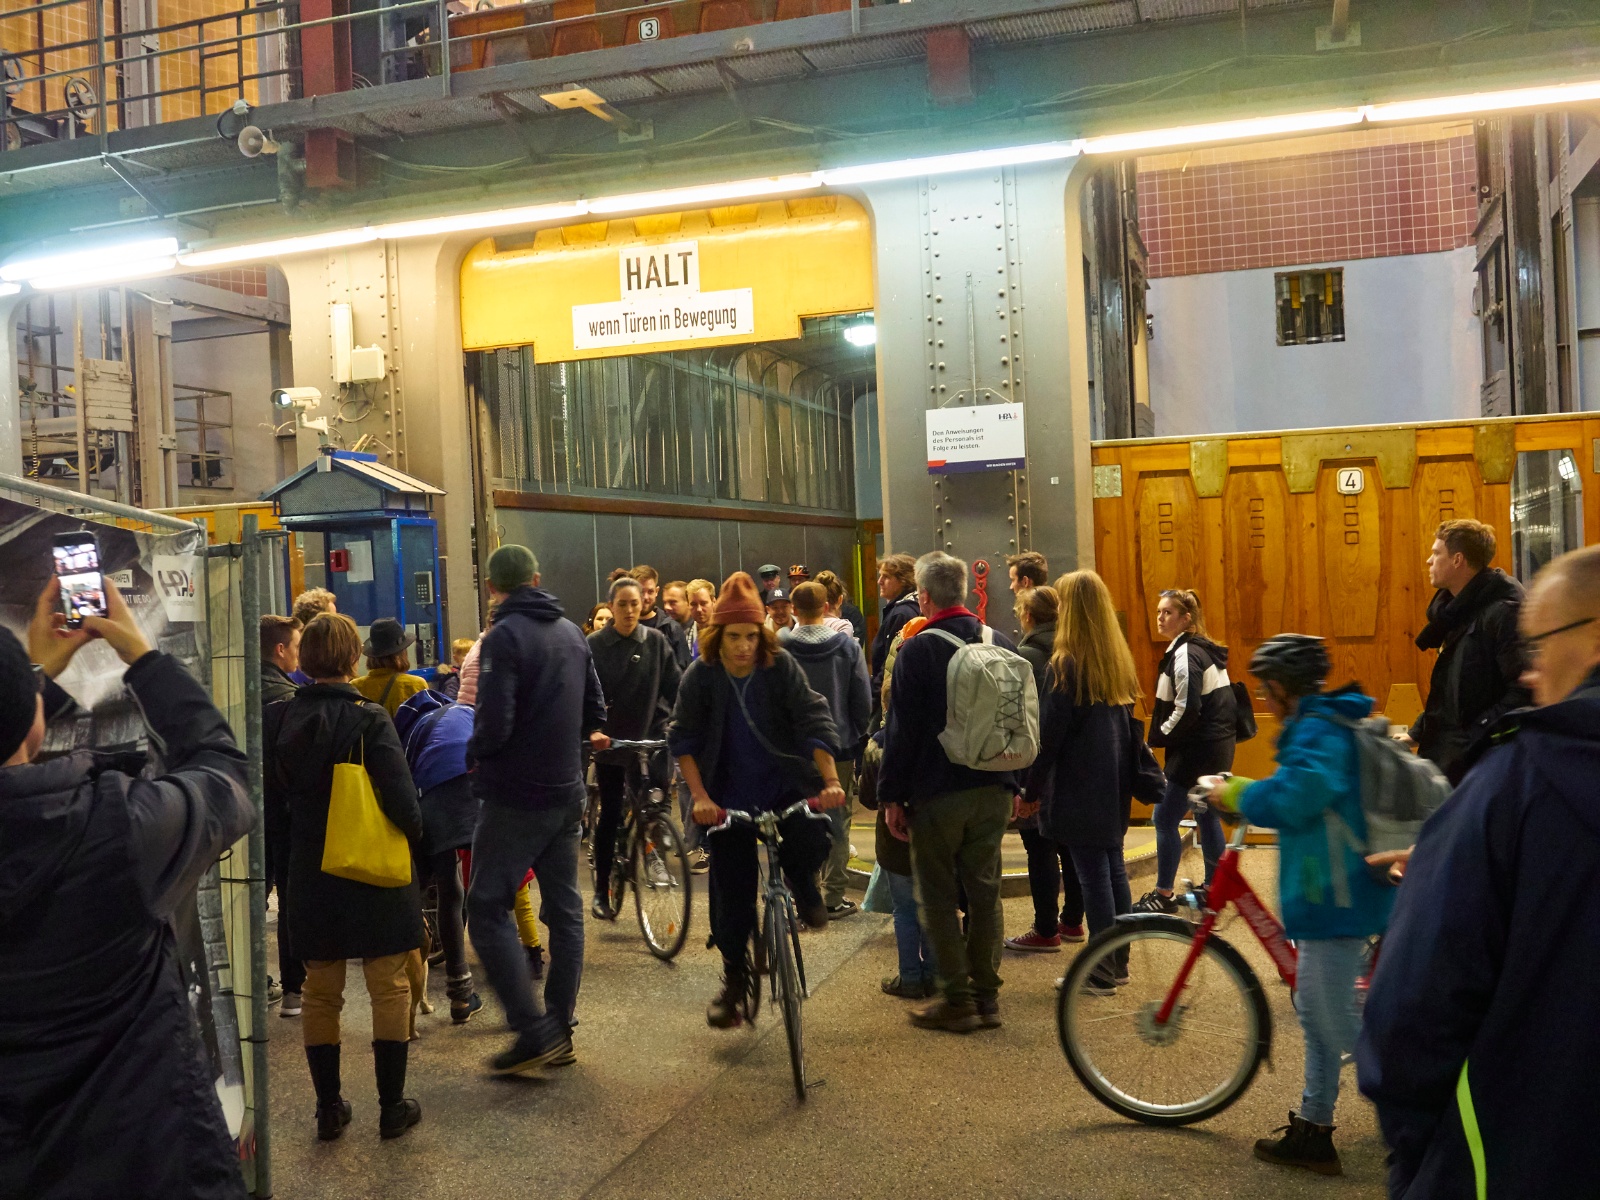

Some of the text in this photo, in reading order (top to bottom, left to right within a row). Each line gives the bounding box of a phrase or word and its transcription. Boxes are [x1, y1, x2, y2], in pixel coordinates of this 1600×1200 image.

[645, 22, 654, 37] 3
[626, 251, 693, 291] HALT
[589, 307, 737, 337] wenn Türen in Bewegung
[1345, 472, 1357, 489] 4
